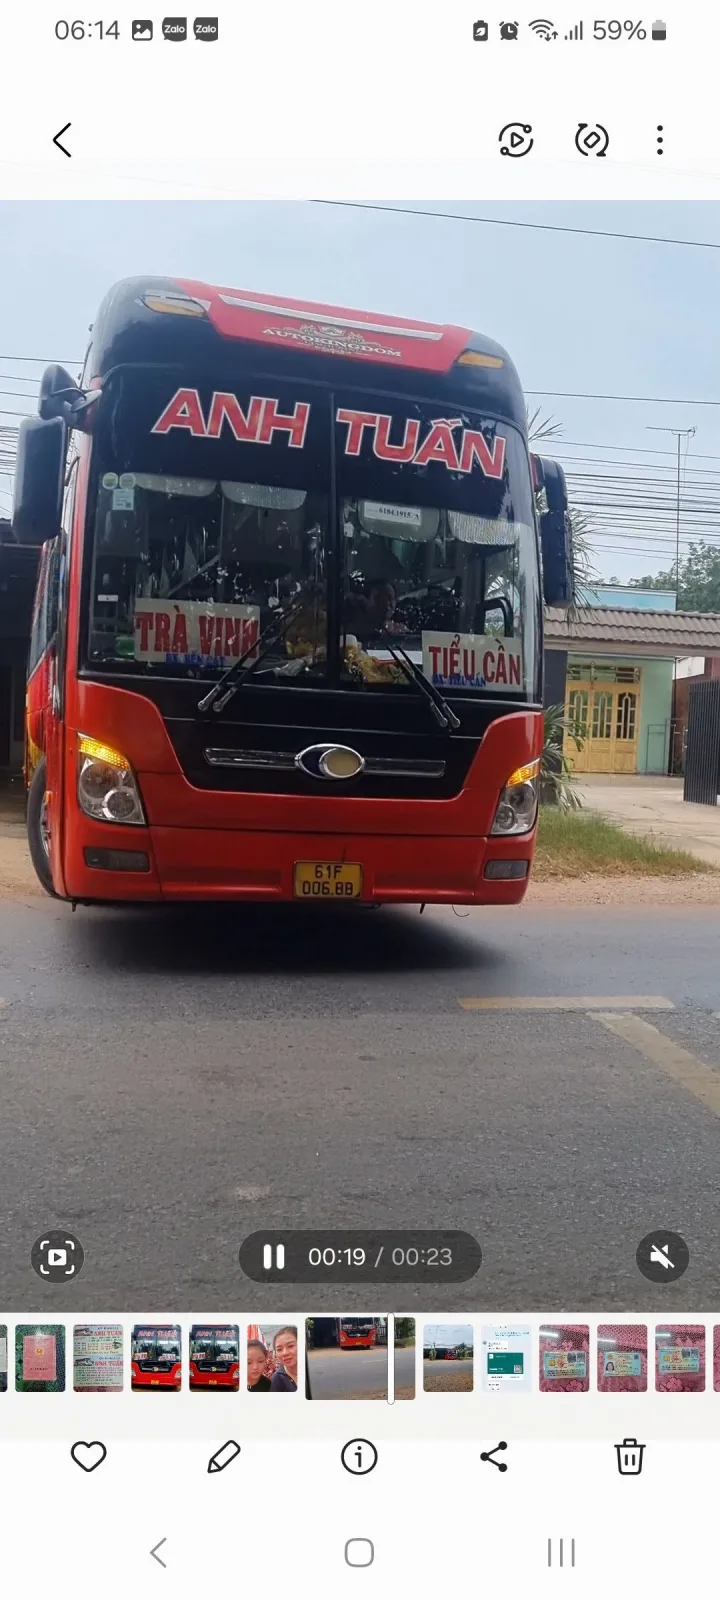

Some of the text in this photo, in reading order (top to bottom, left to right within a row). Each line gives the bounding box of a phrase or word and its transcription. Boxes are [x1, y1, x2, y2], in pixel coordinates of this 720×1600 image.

[262, 328, 403, 357] AUTOKINGDOM
[150, 387, 507, 480] ANH TUẤN
[135, 604, 260, 659] TRÀ VINH
[428, 634, 521, 685] TIỂU CẦN
[301, 881, 354, 897] 006.88
[314, 864, 342, 880] 61F
